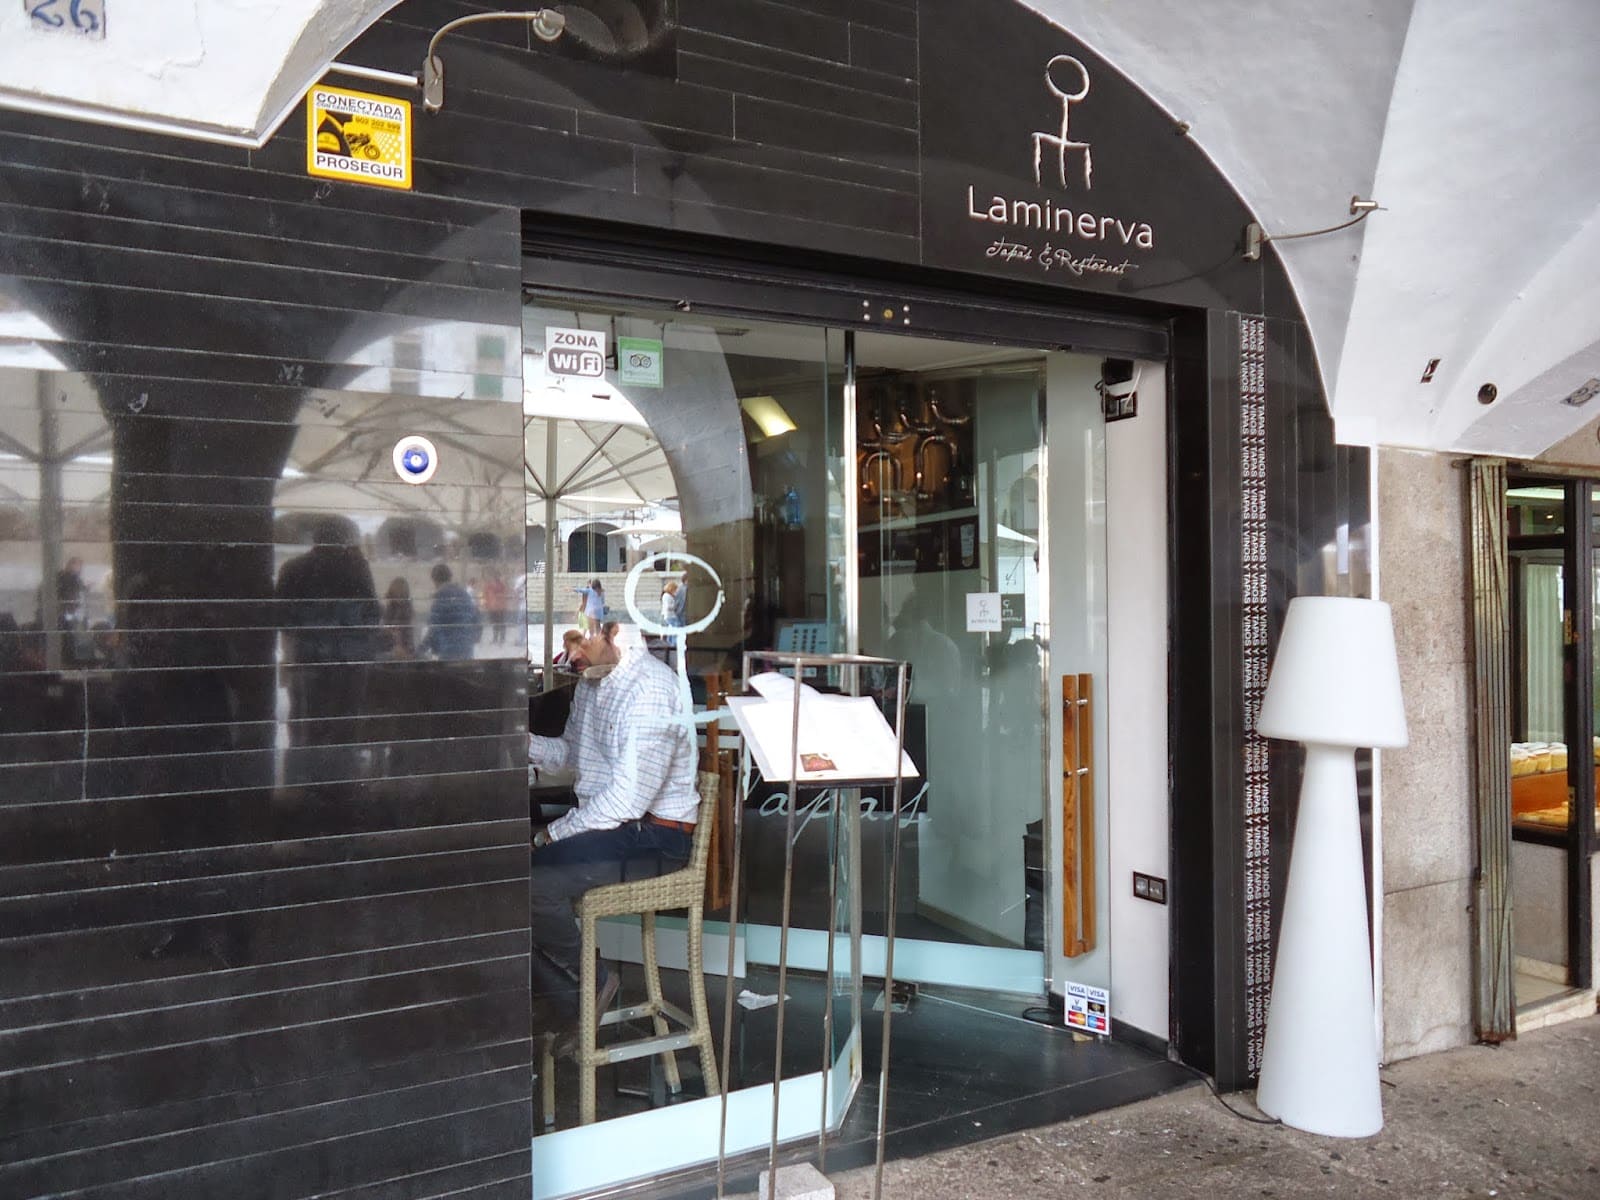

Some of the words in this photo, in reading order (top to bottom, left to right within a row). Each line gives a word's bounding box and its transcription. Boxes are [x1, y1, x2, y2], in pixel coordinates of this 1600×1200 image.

[316, 93, 402, 117] CONECTADA
[316, 155, 403, 178] PROSEGUR
[968, 185, 1153, 248] Laminerva
[986, 236, 1032, 262] Tapas
[554, 333, 598, 347] ZONA
[552, 353, 599, 371] WiFi
[1070, 985, 1085, 993] VISA
[1090, 990, 1105, 998] VISA
